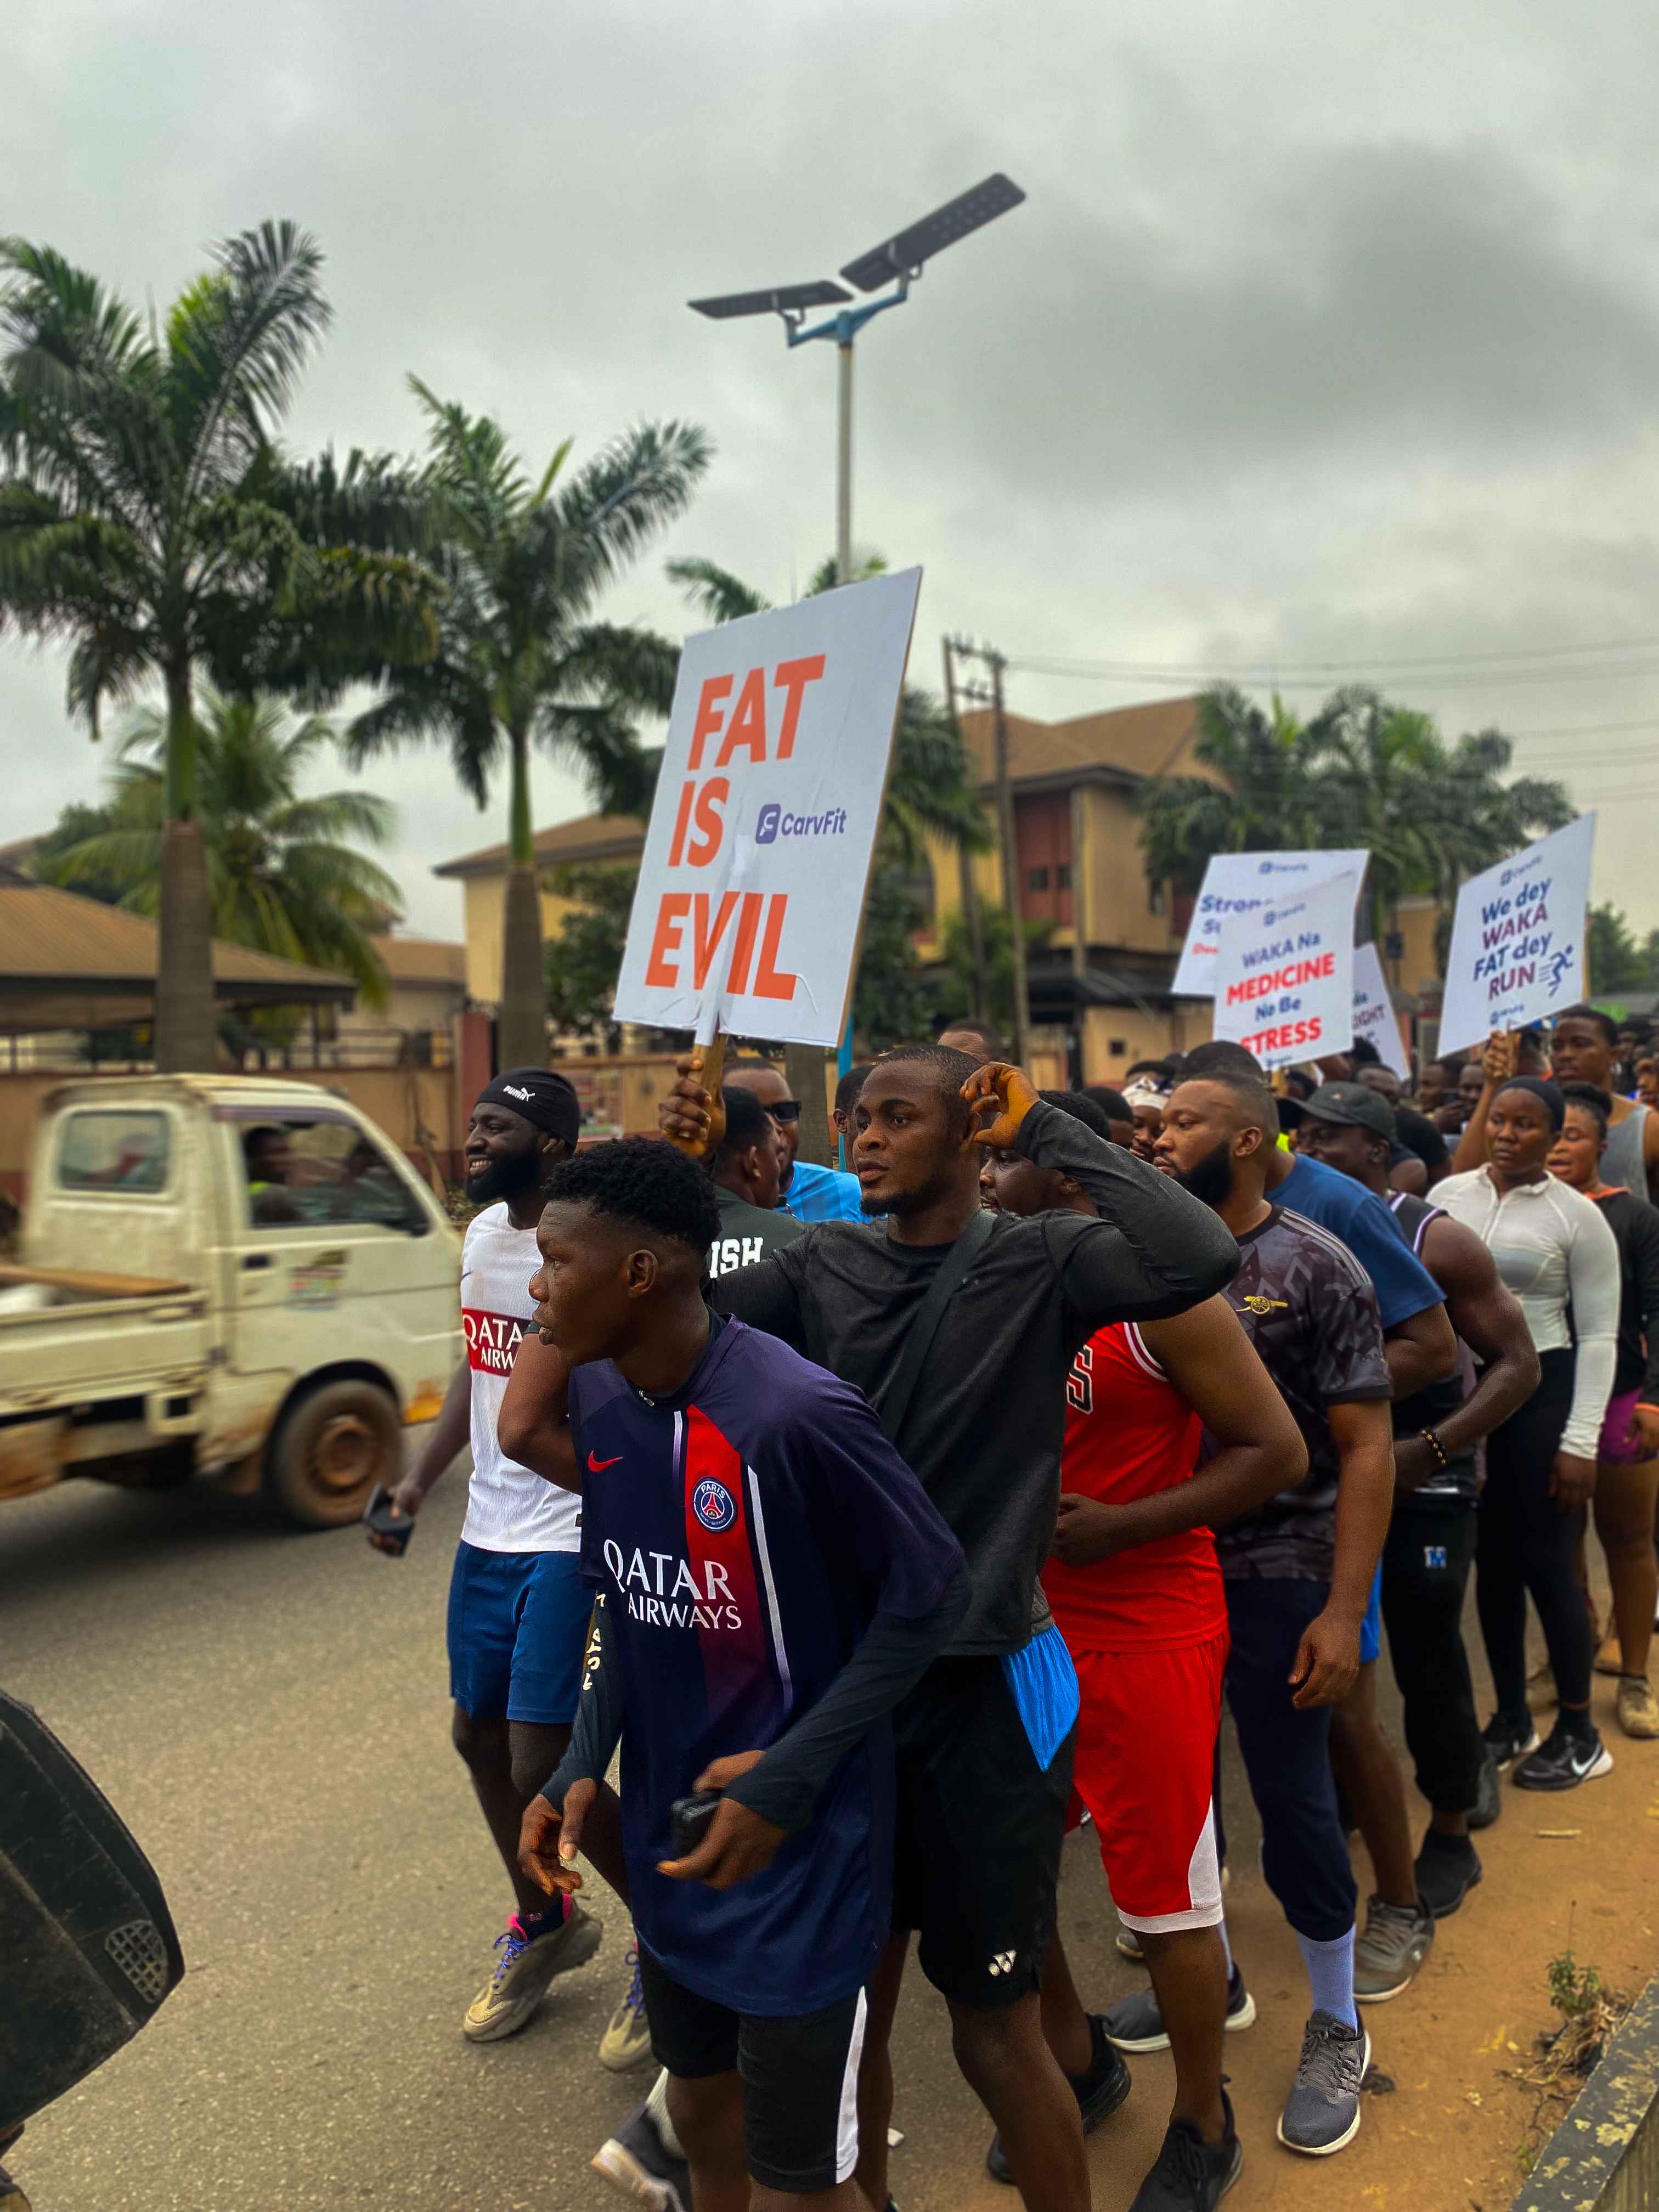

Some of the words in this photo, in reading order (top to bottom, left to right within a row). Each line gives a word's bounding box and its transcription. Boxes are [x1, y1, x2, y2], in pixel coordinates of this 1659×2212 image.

[686, 653, 827, 771] FAT
[668, 777, 730, 868] IS
[781, 807, 847, 836] CarvFit
[1482, 896, 1511, 925] We
[1515, 876, 1553, 908] dey
[645, 890, 797, 1001] EVIL
[1482, 901, 1548, 950] WAKA
[1242, 938, 1294, 968] WAKA
[1474, 944, 1510, 981] FAT
[1513, 932, 1553, 960] dey
[1226, 952, 1335, 1006] MEDICINE
[1488, 961, 1536, 1001] RUN
[1279, 996, 1302, 1013] Be
[1240, 1016, 1322, 1055] STRESS
[503, 1085, 527, 1101] PUMA
[709, 1237, 764, 1279] ISH
[701, 1483, 725, 1499] PARIS
[603, 1538, 736, 1602] QATAR
[628, 1595, 742, 1630] AIRWAYS
